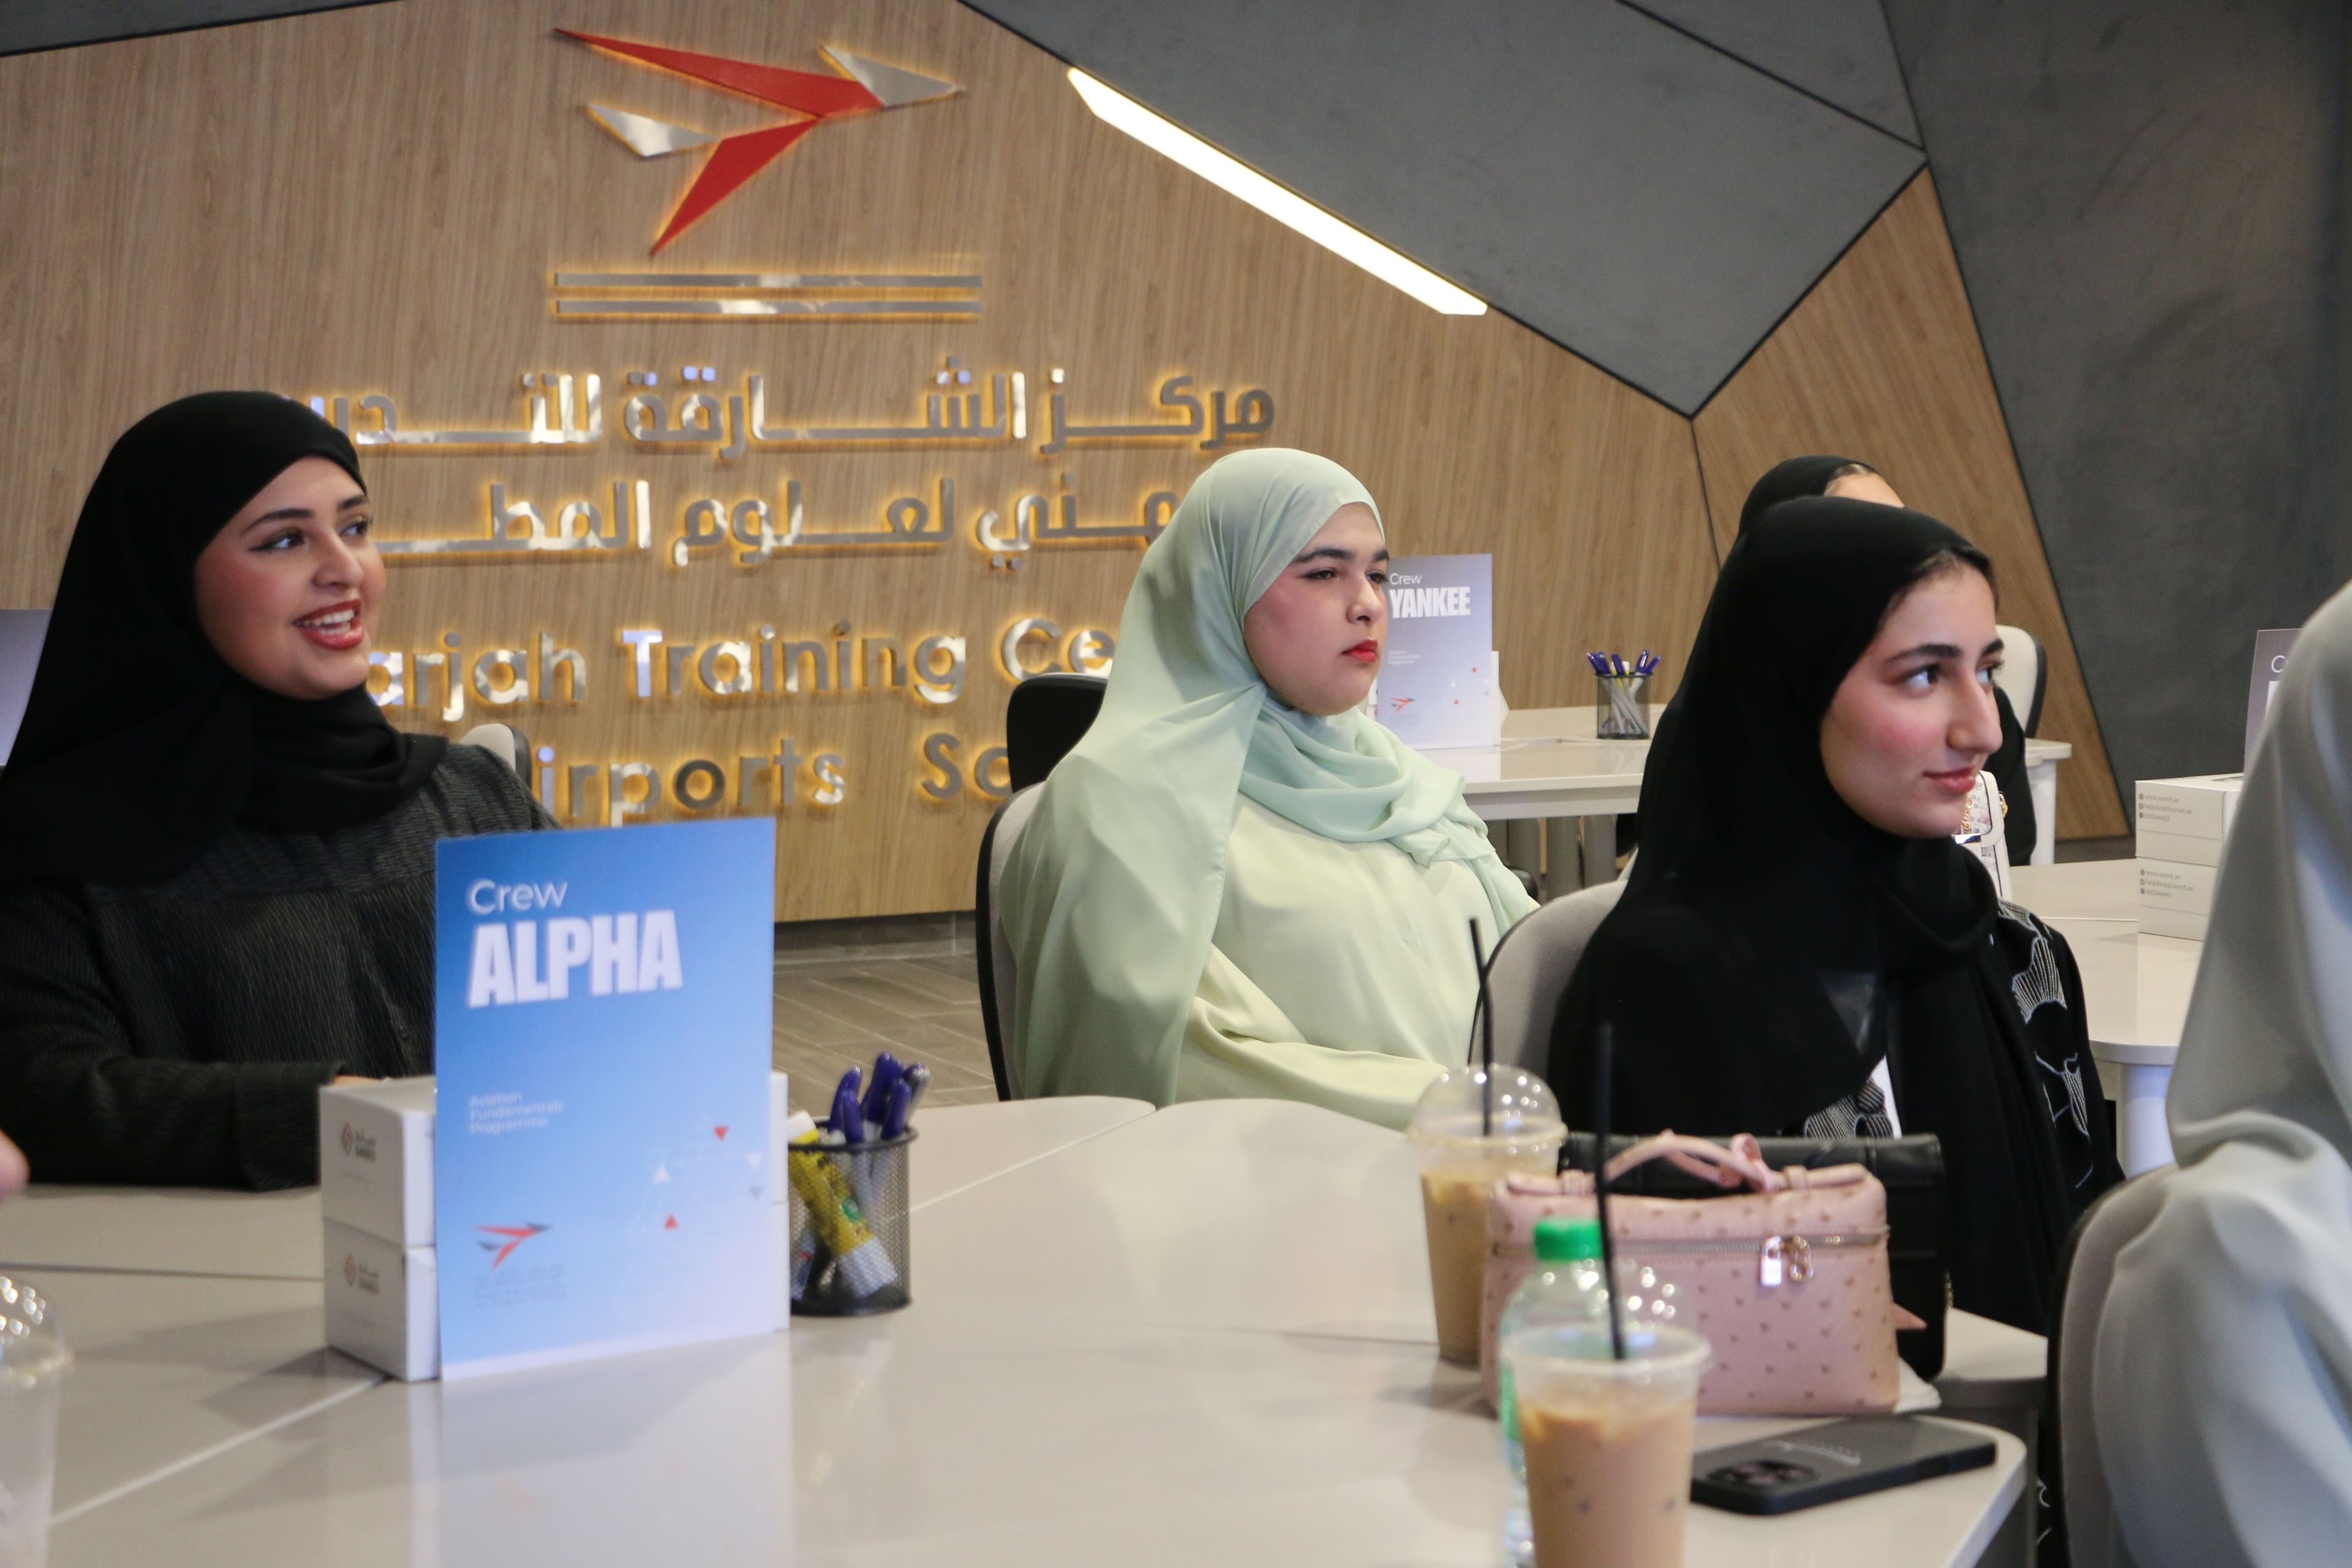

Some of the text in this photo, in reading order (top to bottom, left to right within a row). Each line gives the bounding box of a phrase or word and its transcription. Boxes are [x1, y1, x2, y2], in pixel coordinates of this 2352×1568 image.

[625, 357, 1027, 459] الشارقة
[1040, 368, 1274, 453] مركز
[674, 478, 954, 567] لعلوم
[1388, 586, 1471, 619] YANKEE
[1390, 572, 1422, 585] Crew
[367, 631, 587, 723] arjah
[621, 619, 967, 704] Training
[537, 738, 846, 828] irports
[469, 879, 569, 915] Crew
[467, 909, 683, 1009] ALPHA
